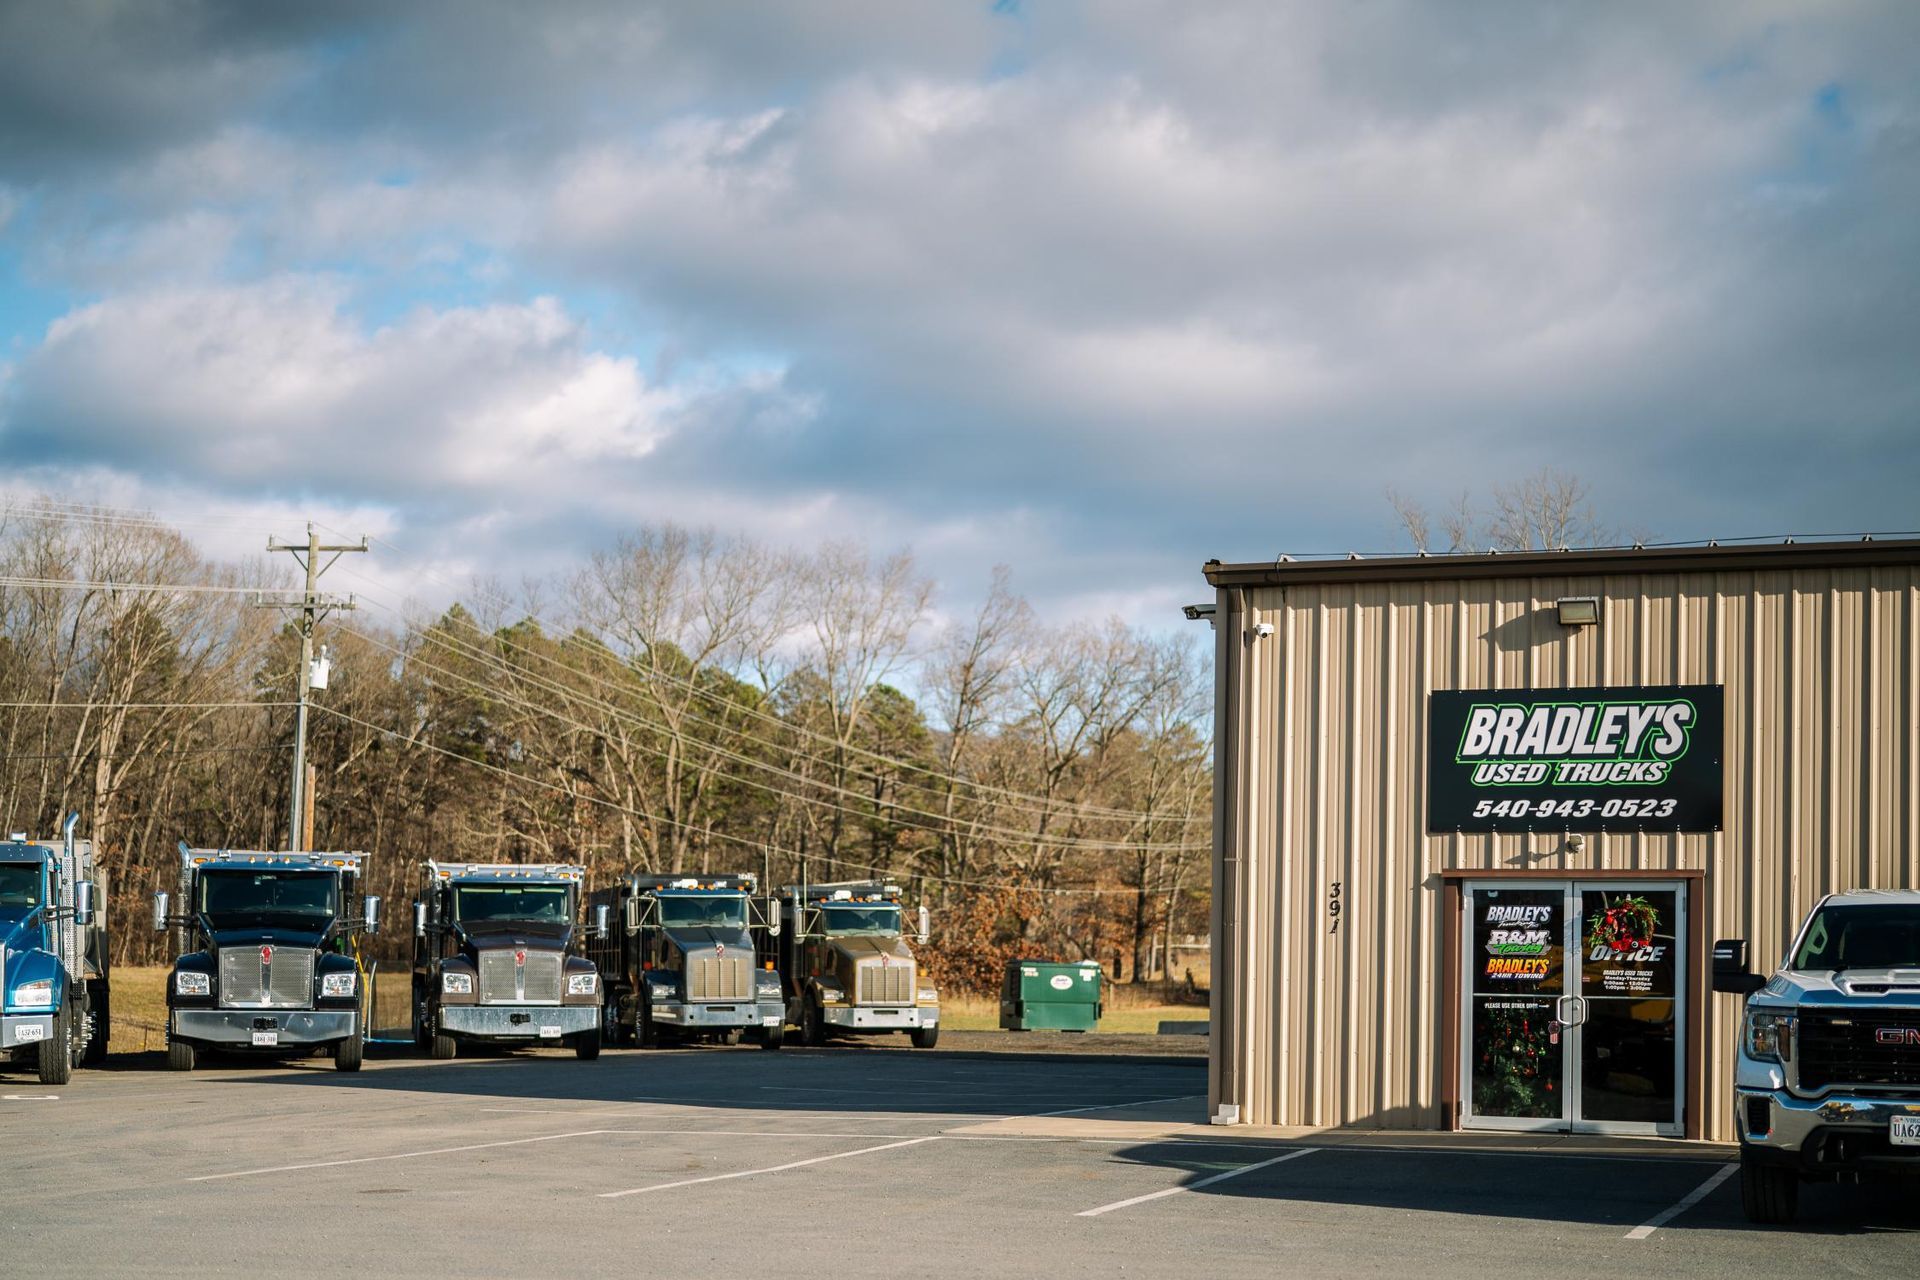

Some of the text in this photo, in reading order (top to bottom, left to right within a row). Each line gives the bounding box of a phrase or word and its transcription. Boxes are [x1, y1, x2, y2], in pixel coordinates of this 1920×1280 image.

[1461, 703, 1691, 756] BRADLEY'S
[1474, 761, 1668, 782] USED TRUCKS
[1472, 799, 1678, 818] 540-943-0523
[1487, 906, 1551, 921] BRADLEY'S
[1489, 931, 1548, 945] R&M
[1487, 959, 1550, 974] BRADLEY'S
